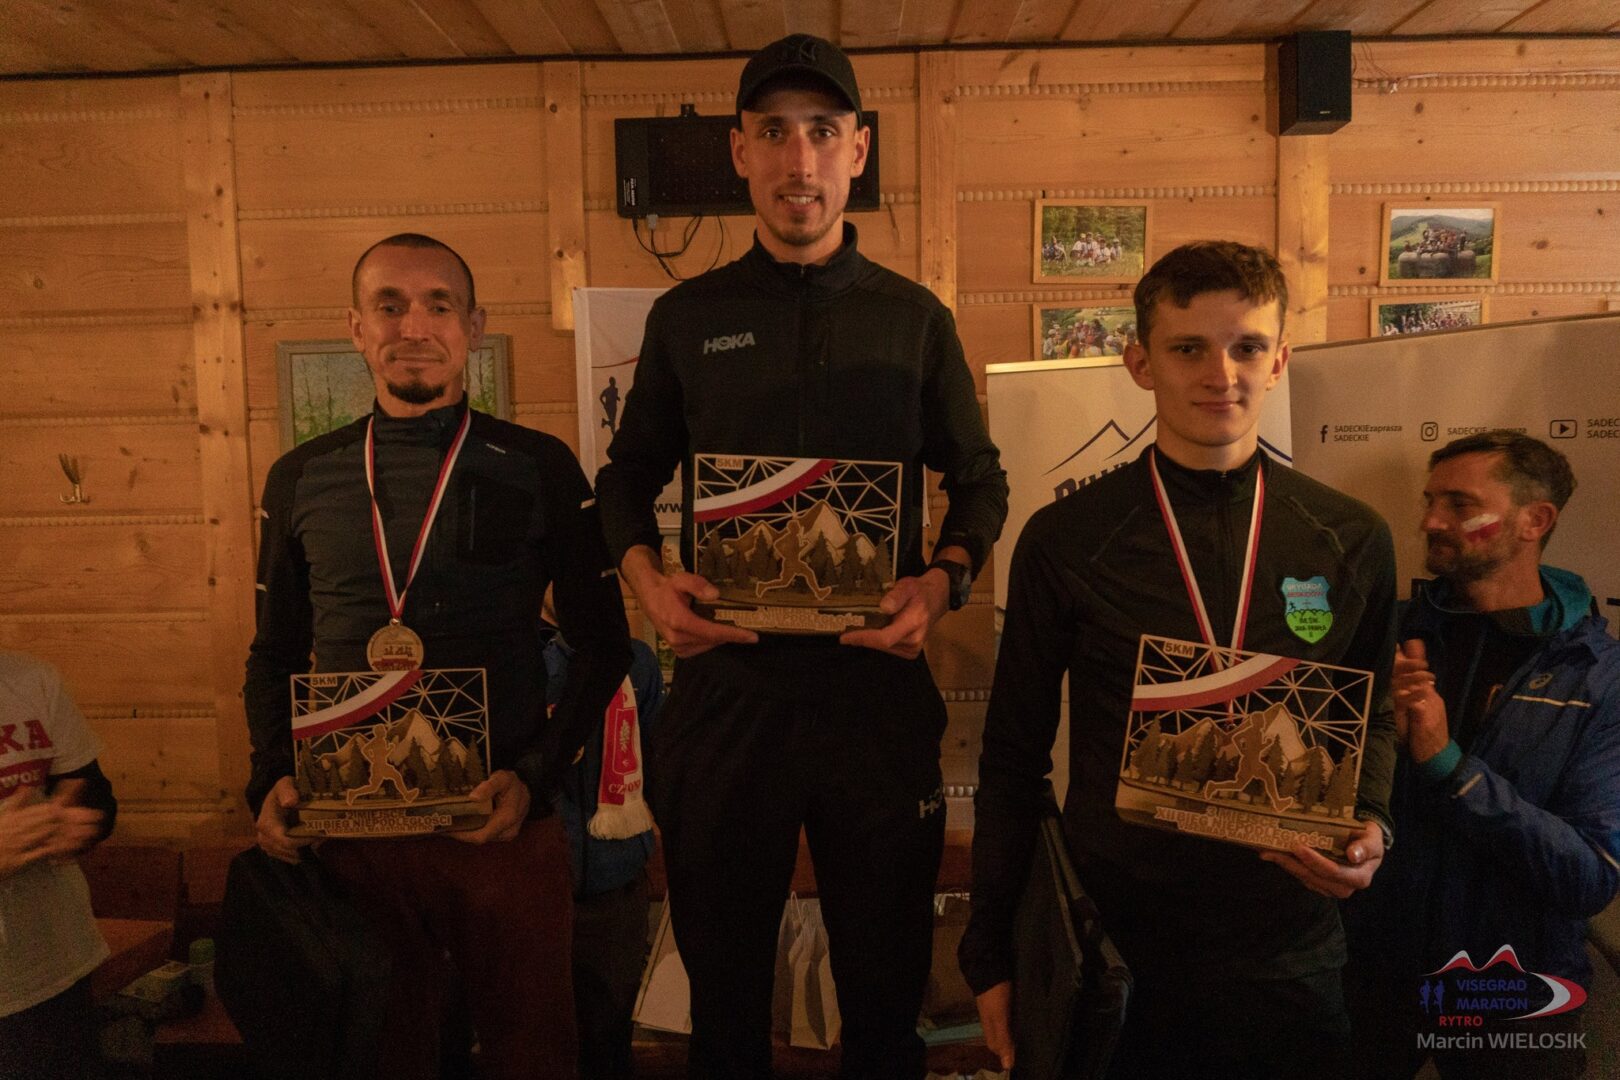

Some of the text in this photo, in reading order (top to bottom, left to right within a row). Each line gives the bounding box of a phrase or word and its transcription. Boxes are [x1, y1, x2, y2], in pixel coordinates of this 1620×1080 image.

[703, 331, 756, 355] HOKA
[1165, 642, 1194, 656] 5KM
[312, 676, 337, 686] 5KM
